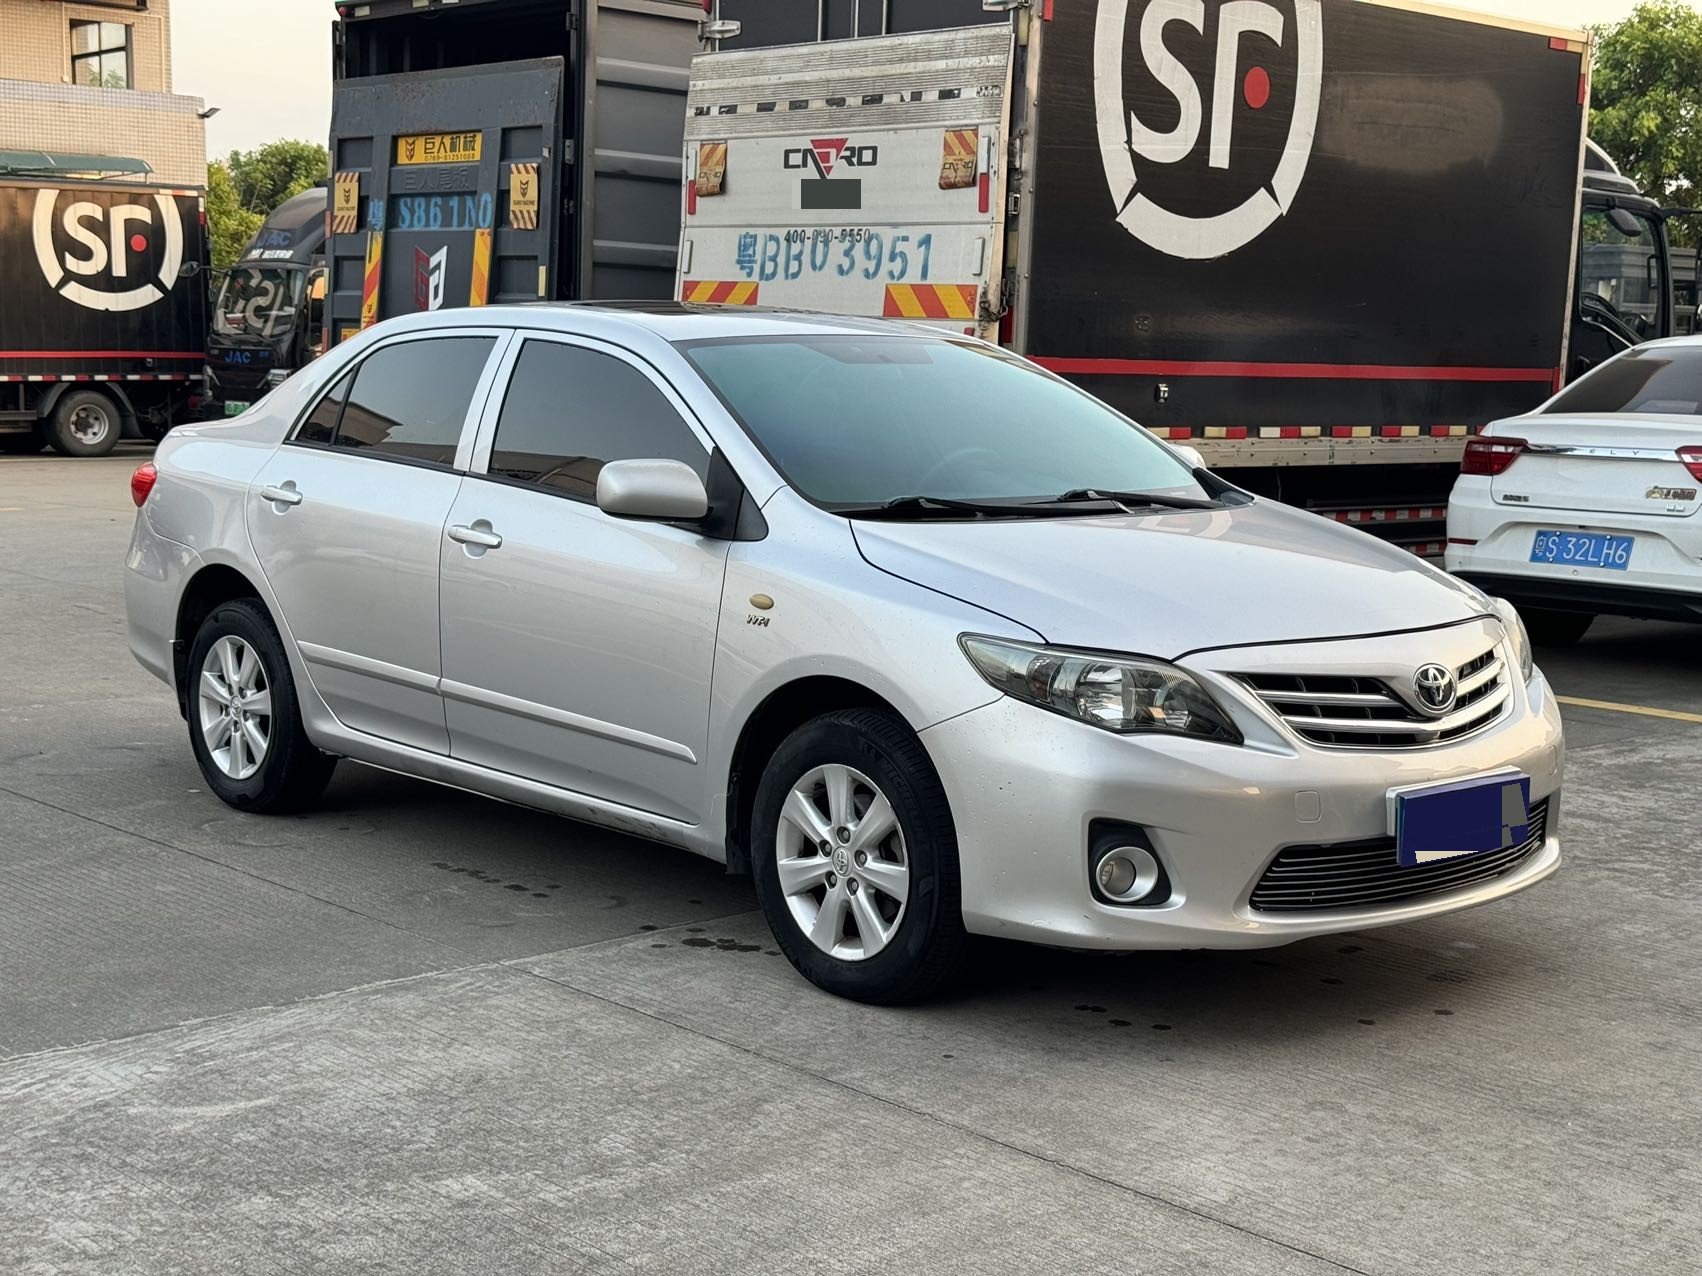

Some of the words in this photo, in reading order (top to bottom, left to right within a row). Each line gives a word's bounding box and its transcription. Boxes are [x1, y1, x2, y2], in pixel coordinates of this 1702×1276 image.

[424, 133, 477, 155] 巨人机械
[225, 350, 252, 364] JAC
